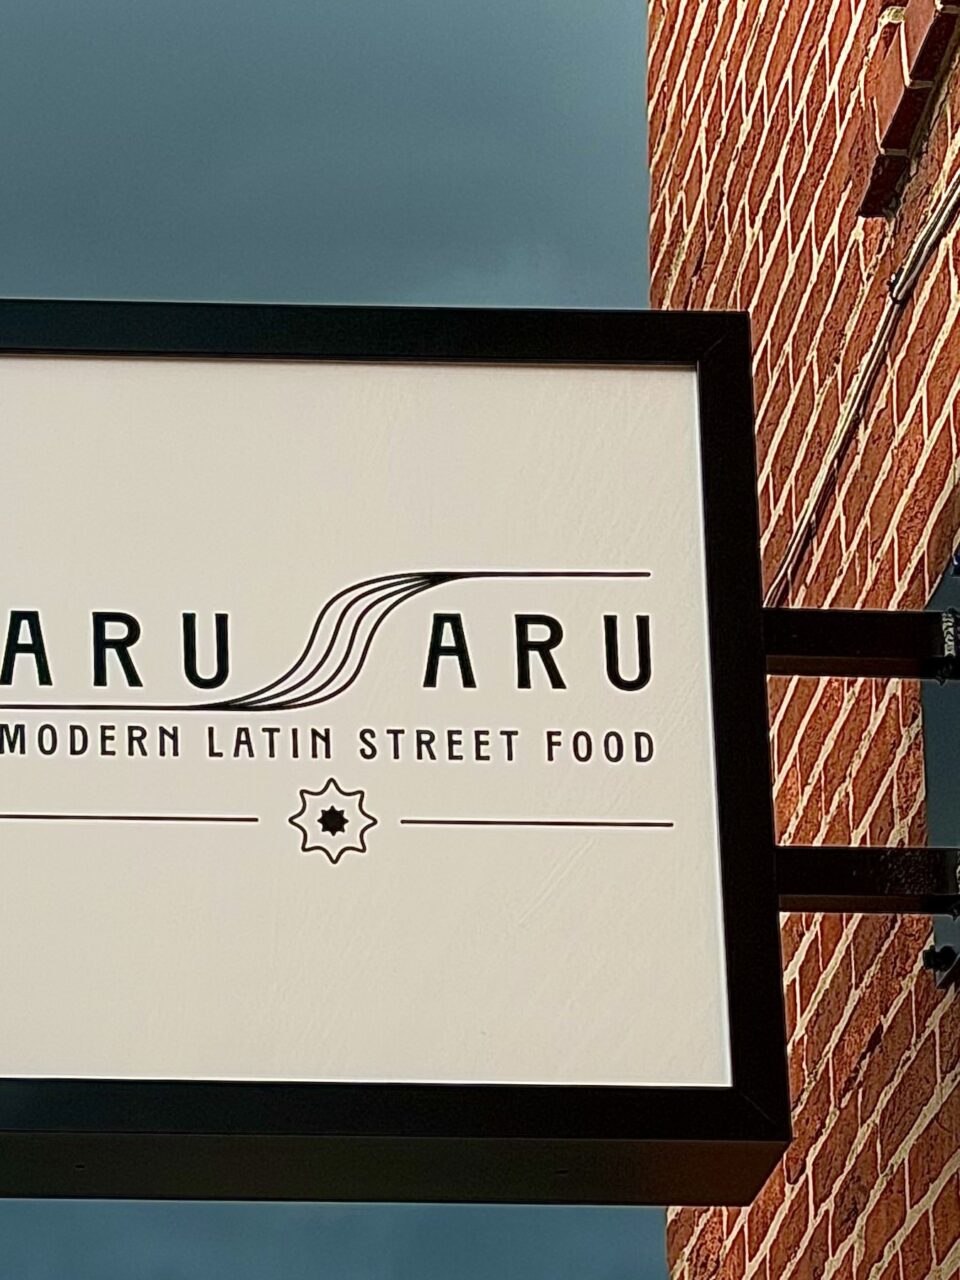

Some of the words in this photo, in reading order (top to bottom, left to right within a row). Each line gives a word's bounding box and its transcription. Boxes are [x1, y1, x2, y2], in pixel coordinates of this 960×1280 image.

[422, 612, 652, 692] ARU
[206, 726, 332, 760] LATIN
[359, 728, 519, 762] STREET
[546, 730, 654, 764] FOOD
